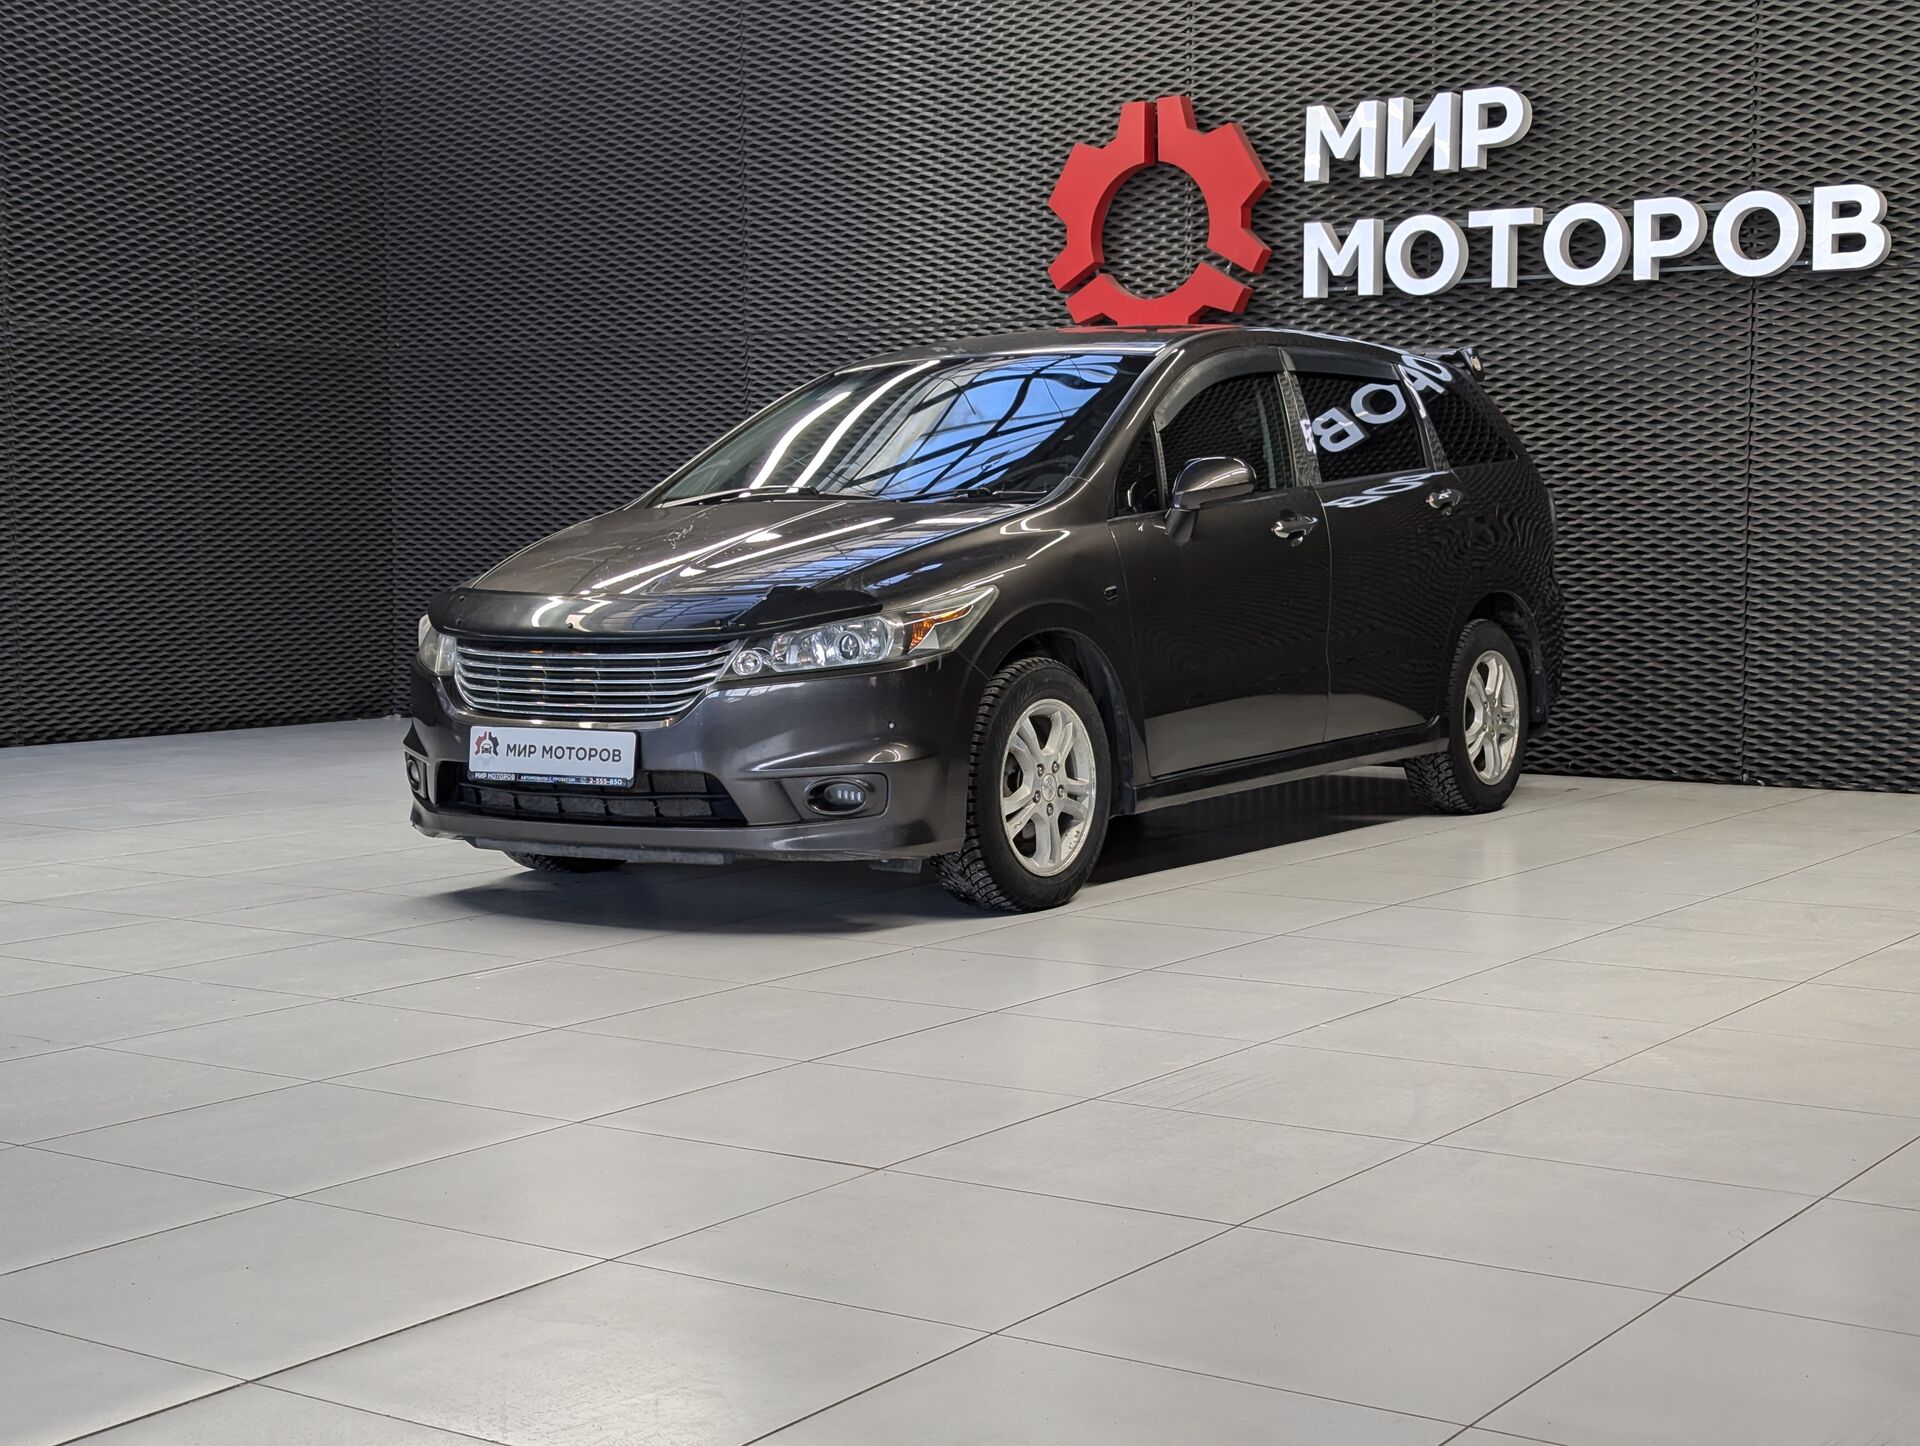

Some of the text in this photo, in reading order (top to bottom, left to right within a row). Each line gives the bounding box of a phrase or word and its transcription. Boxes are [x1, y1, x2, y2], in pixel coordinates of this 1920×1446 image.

[1304, 86, 1532, 183] МИР
[1303, 184, 1891, 298] МОТОРОВ
[488, 773, 515, 781] МОТОРОВ
[505, 743, 622, 763] МИР МОТОРОВ
